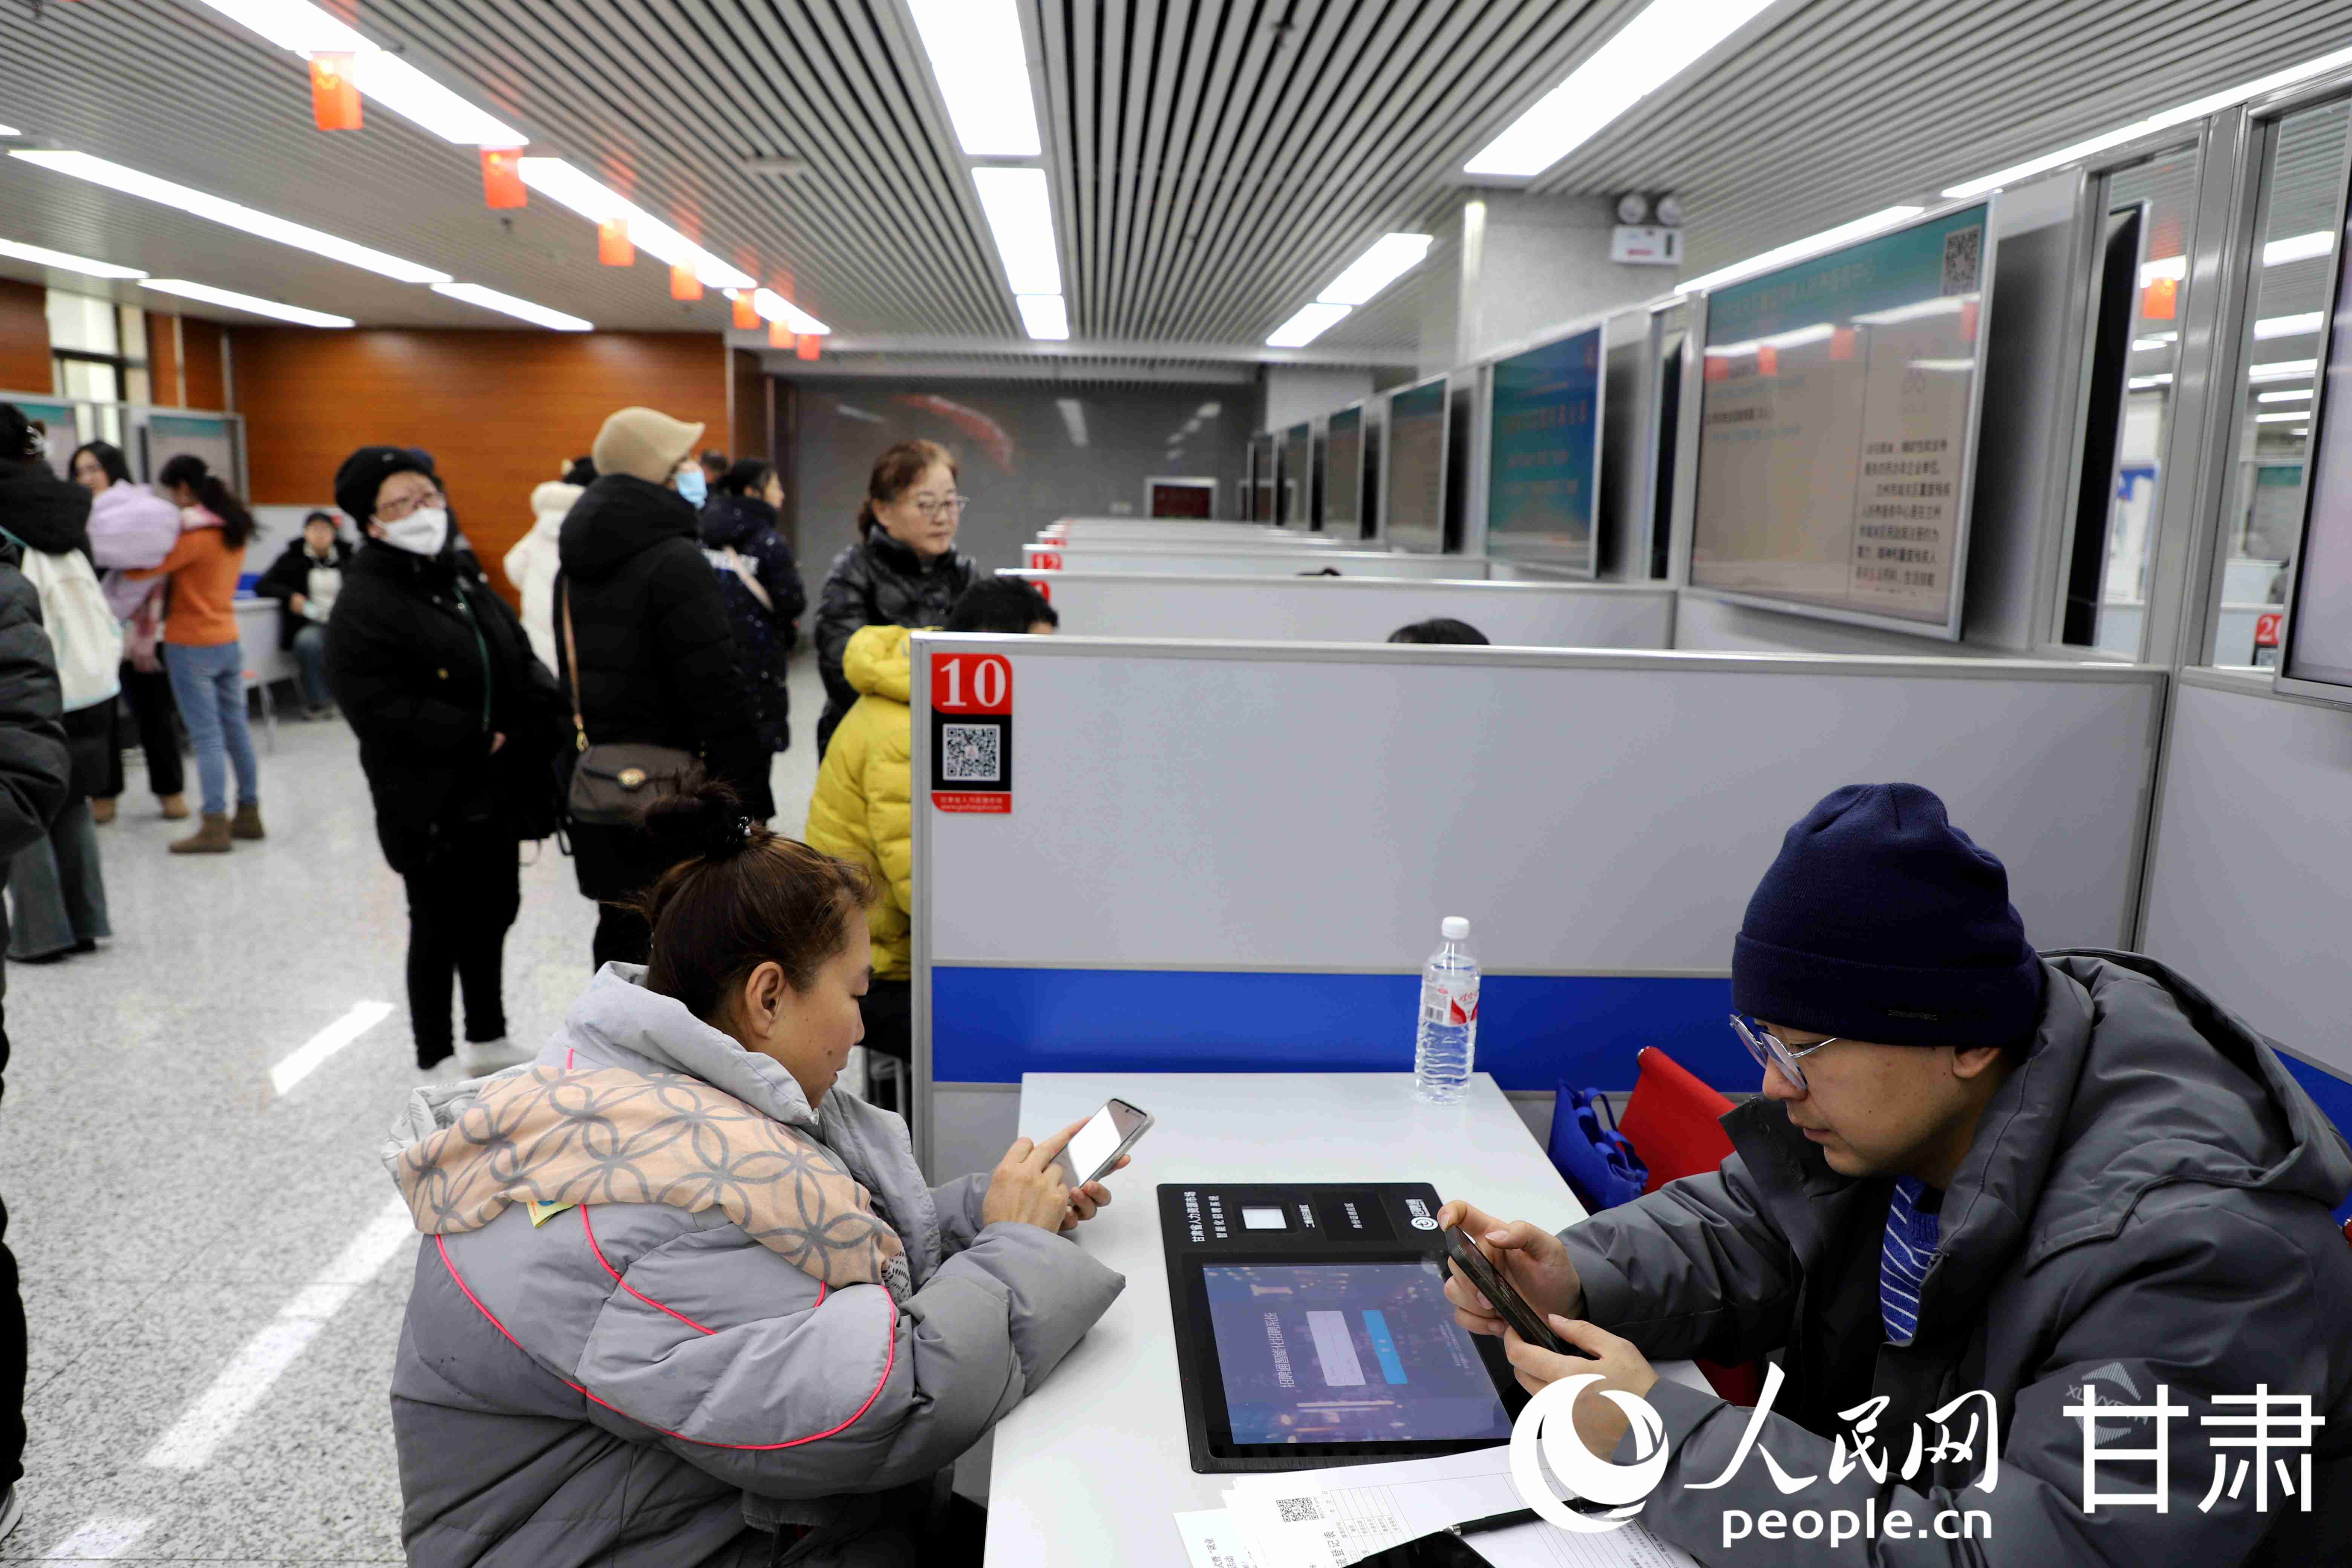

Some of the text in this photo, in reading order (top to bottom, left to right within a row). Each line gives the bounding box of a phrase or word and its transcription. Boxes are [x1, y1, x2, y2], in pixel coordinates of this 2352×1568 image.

[939, 658, 1006, 707] 10
[1184, 1191, 1205, 1242] 甘肃省人力资源市场
[1208, 1195, 1228, 1238] 智能化招聘系统
[1263, 1312, 1295, 1388] 招聘通智能化招聘系统
